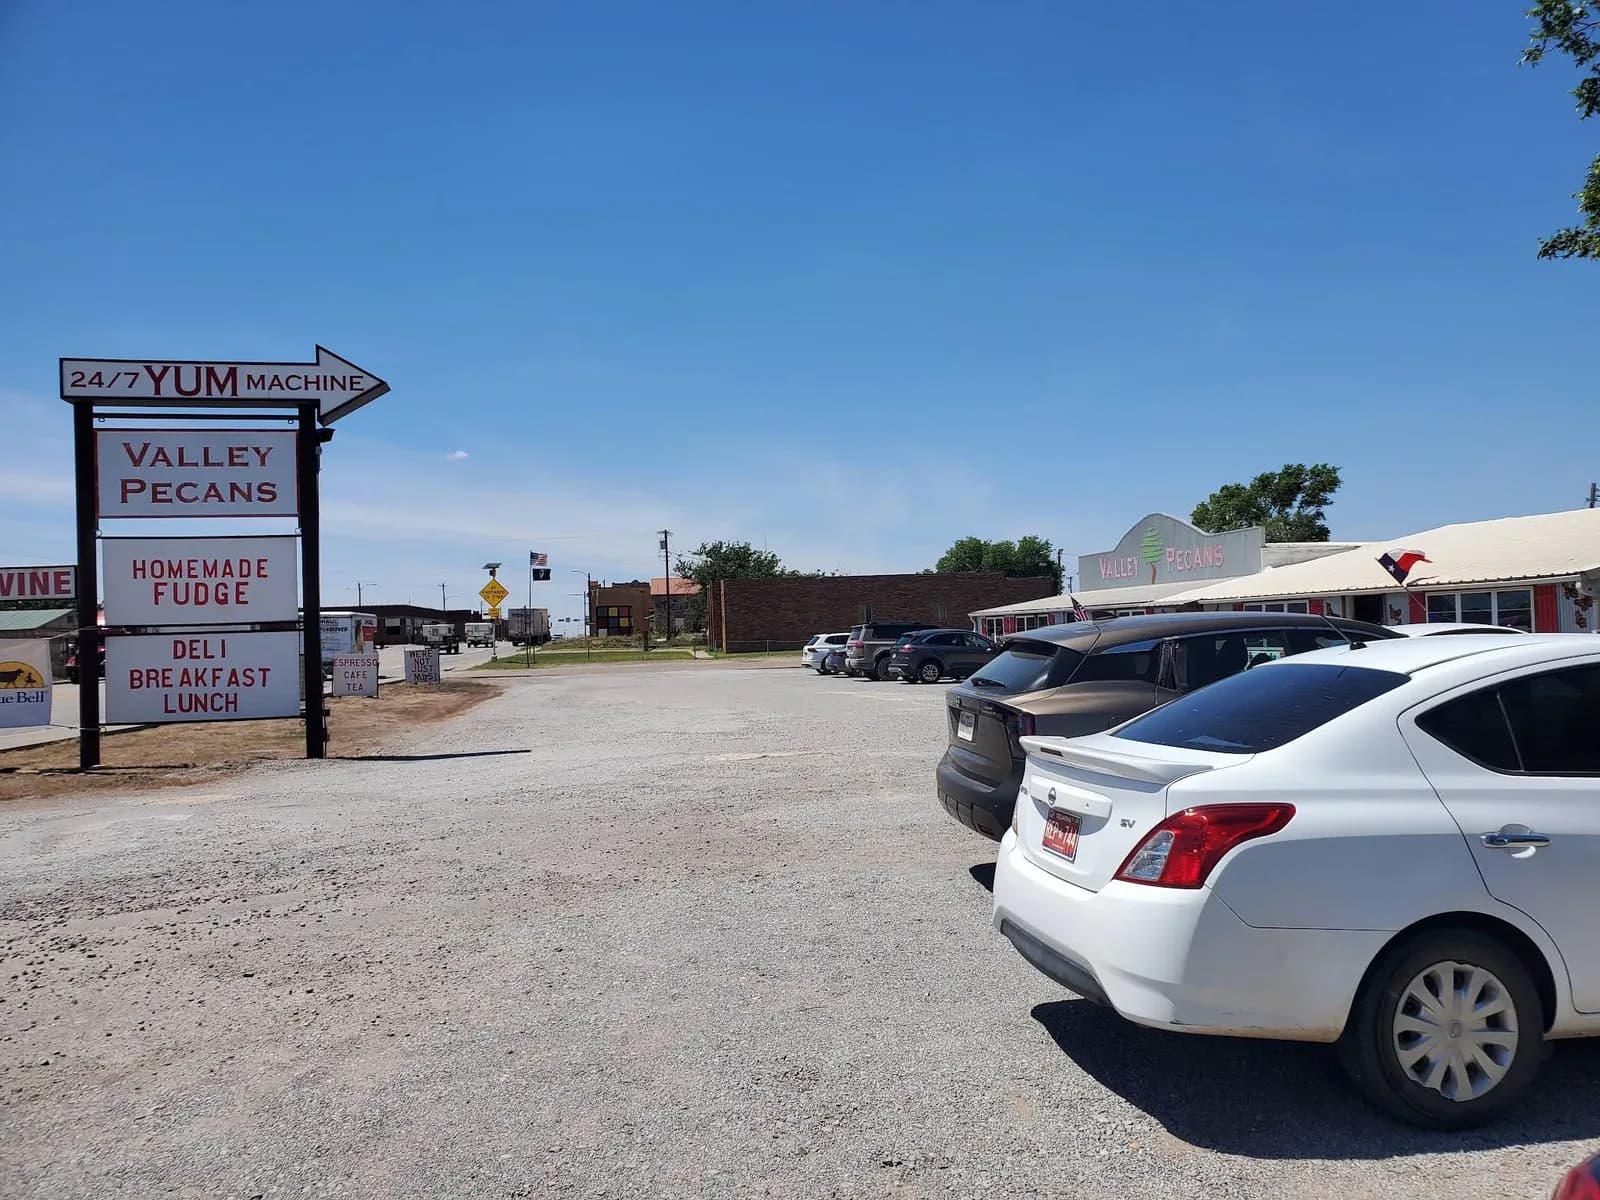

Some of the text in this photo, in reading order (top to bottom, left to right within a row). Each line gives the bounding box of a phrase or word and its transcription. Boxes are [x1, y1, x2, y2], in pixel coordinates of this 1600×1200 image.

[70, 364, 365, 397] 24/7 YUM MACHINE
[121, 442, 275, 468] VALLEY
[119, 478, 278, 504] PECANS
[132, 558, 269, 579] HOMEMADE
[1099, 556, 1140, 579] VALLEY
[1165, 544, 1225, 573] PECANS
[153, 581, 249, 606] FUDGE
[173, 639, 226, 660] DELI
[333, 659, 377, 667] ESPRESSO
[412, 664, 433, 673] JUST
[129, 668, 271, 690] BREAKFAST
[344, 671, 367, 679] CAFE
[16, 691, 45, 704] Bell
[345, 683, 364, 691] TEA
[164, 693, 238, 714] LUNCH
